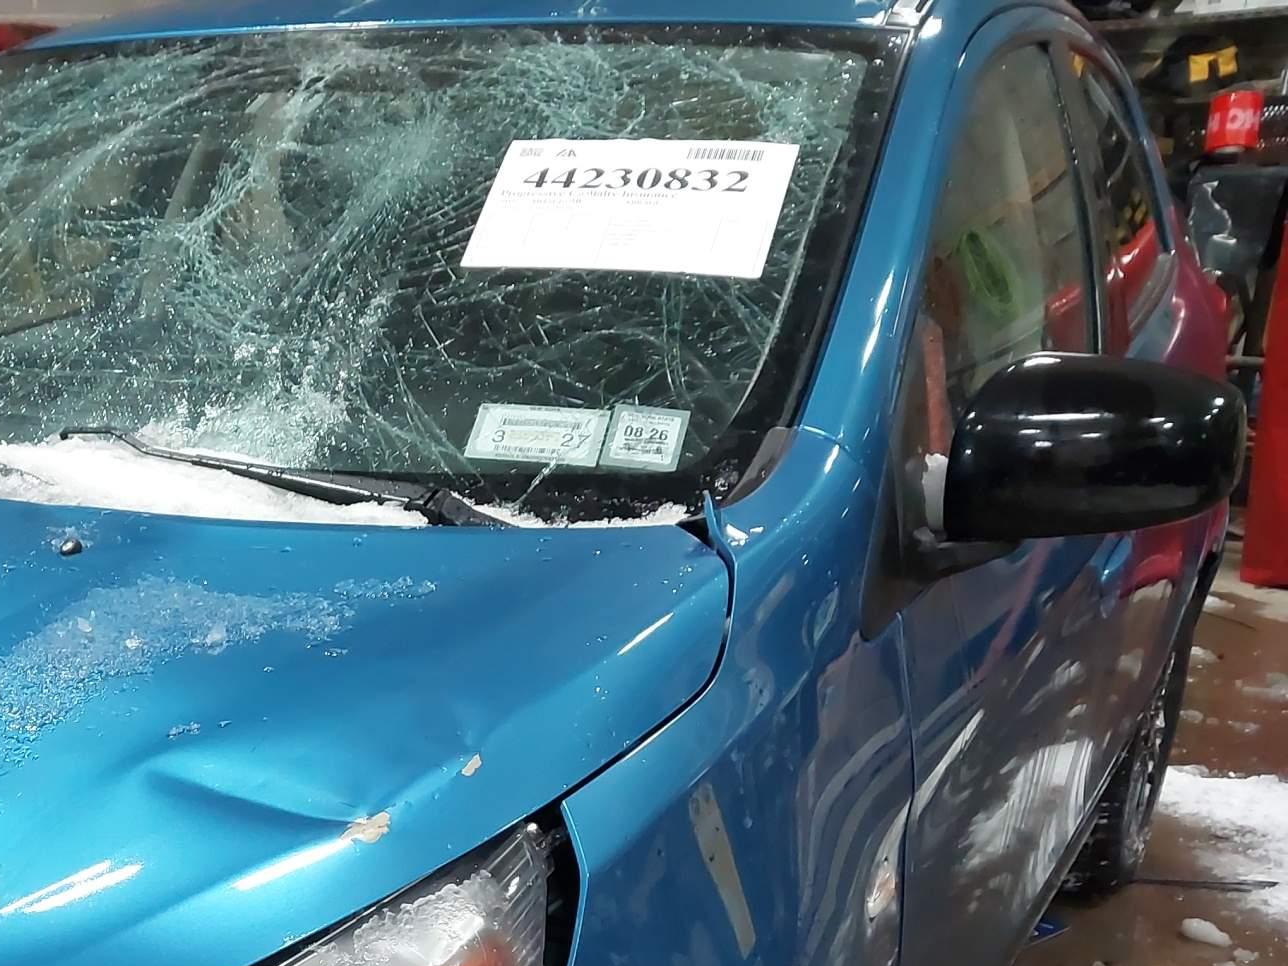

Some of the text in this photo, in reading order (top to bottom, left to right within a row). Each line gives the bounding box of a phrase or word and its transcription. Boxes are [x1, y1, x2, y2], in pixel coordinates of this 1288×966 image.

[523, 168, 749, 192] 44230832
[492, 429, 592, 449] 3 27
[624, 425, 668, 441] 08 26
